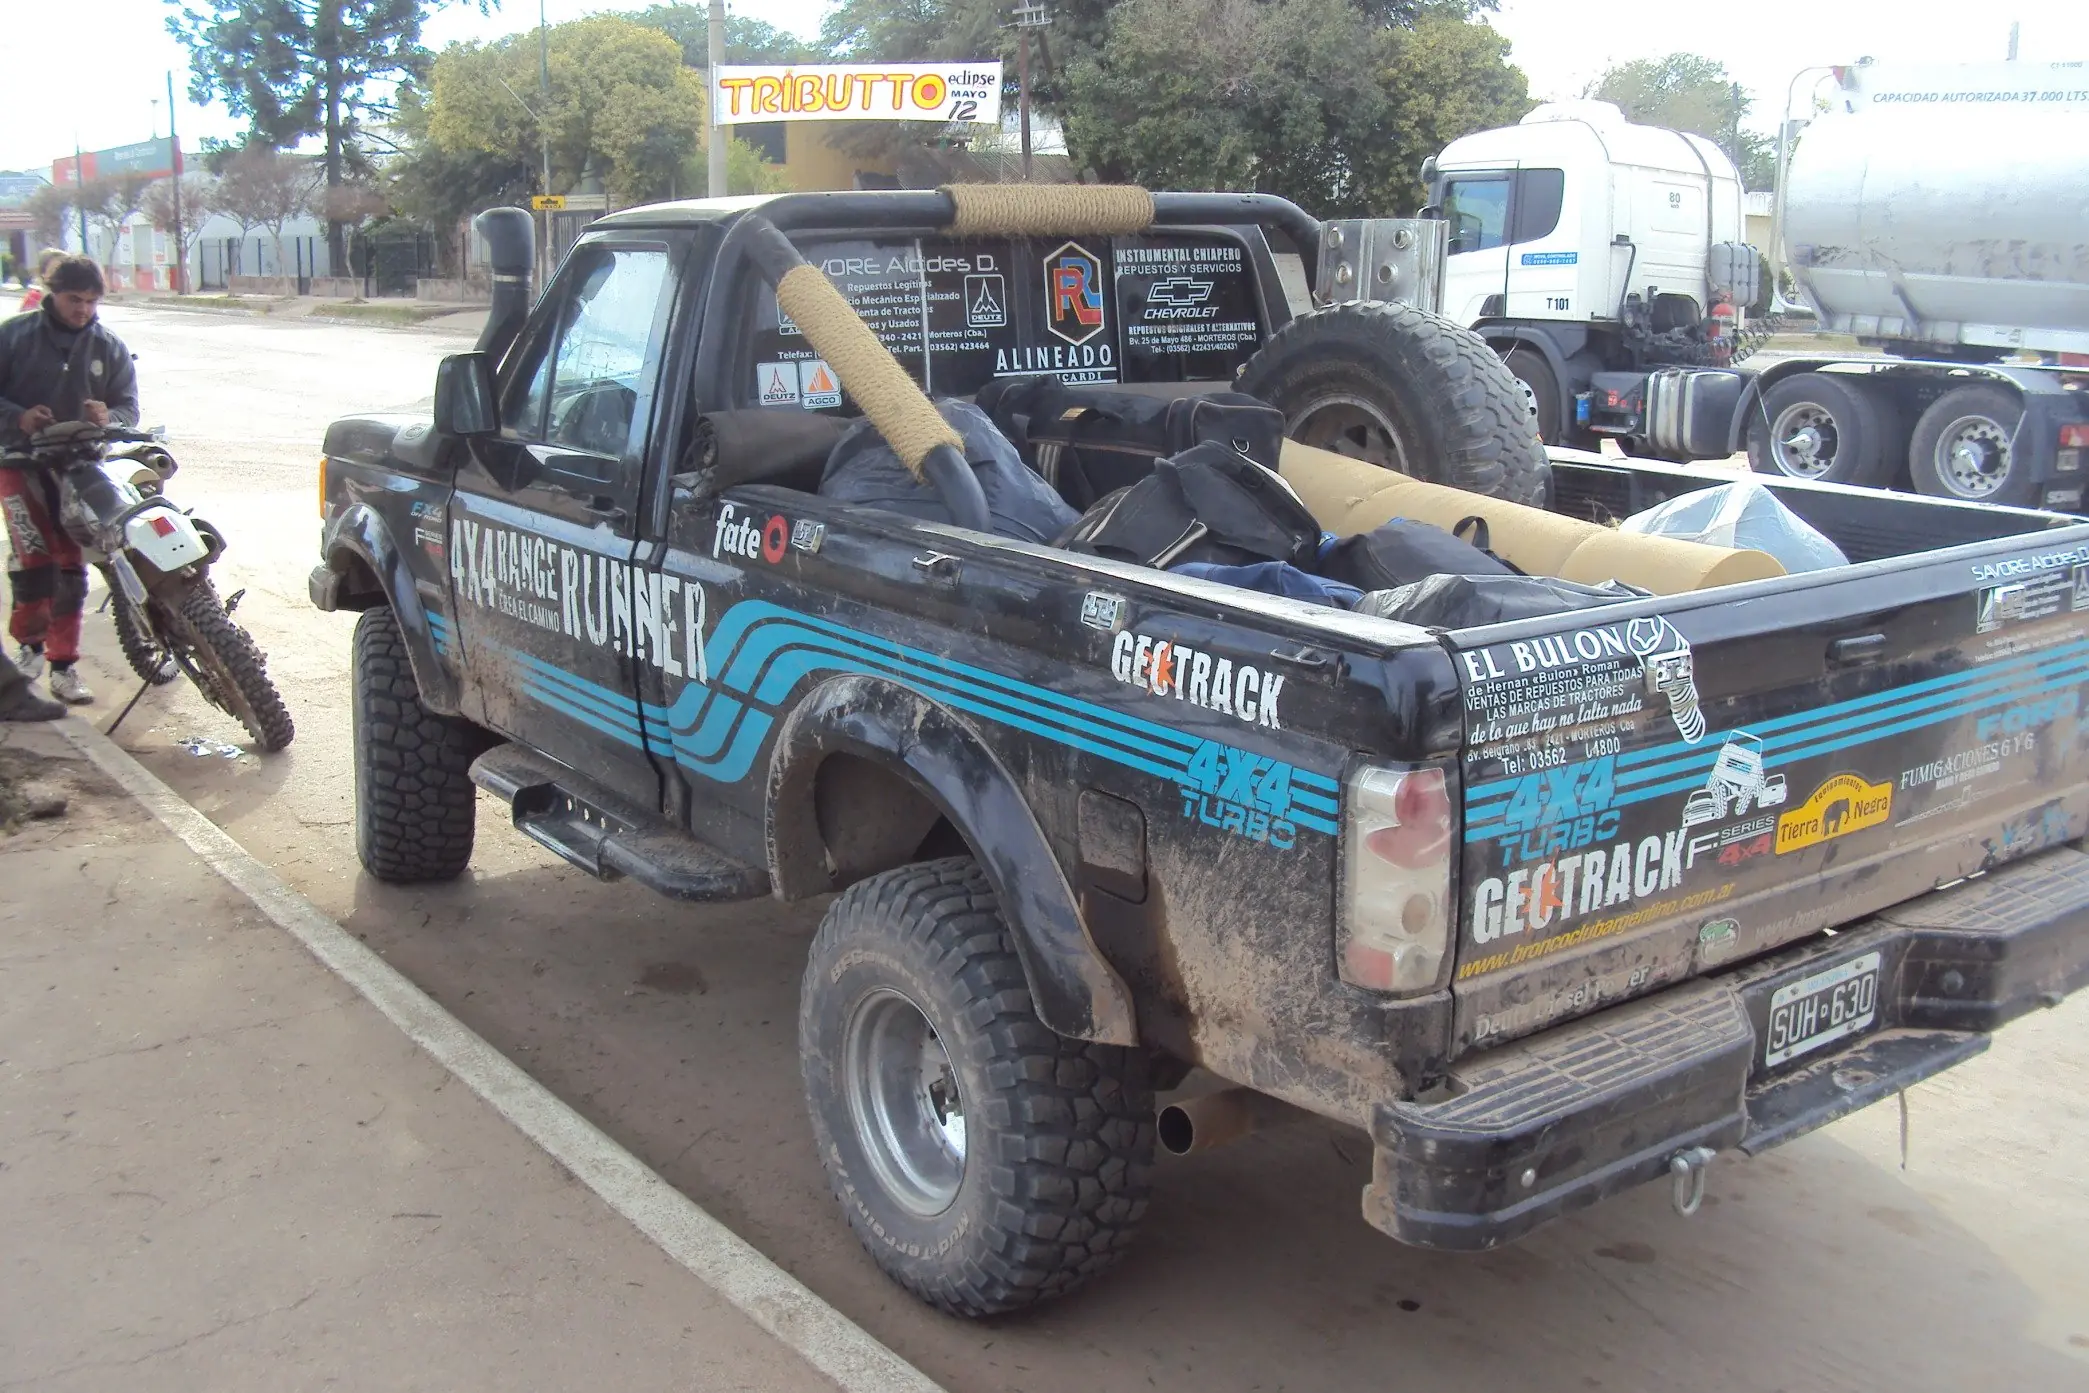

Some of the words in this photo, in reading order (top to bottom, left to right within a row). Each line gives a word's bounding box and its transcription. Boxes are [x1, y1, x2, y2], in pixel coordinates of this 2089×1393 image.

[948, 70, 995, 87] eclipse
[951, 91, 987, 99] MAYO
[1873, 93, 1938, 103] CAPACIDAD
[1941, 92, 2019, 102] AUTORIZADA
[2021, 91, 2063, 102] 37.000
[949, 101, 978, 120] 12
[1669, 192, 1681, 203] 80
[1116, 249, 1190, 263] INSTRUMENTAL
[1193, 248, 1241, 261] CHIAPERO
[1117, 264, 1177, 275] REPUESTOS
[1180, 264, 1187, 273] Y
[1190, 263, 1242, 273] SERVICIOS
[848, 282, 892, 293] Repuestos
[862, 294, 902, 306] Mecánico
[1555, 298, 1569, 310] 101
[881, 307, 892, 316] de
[893, 305, 933, 316] Tractoes
[1144, 306, 1219, 319] CHEVROLET
[881, 323, 887, 331] y
[888, 319, 920, 328] Usados
[901, 332, 922, 341] 2421
[1151, 336, 1160, 344] de
[1161, 336, 1179, 345] Mayo
[1198, 333, 1236, 342] MORTEROS
[778, 350, 813, 359] Telefax:
[887, 345, 902, 353] Tel.
[904, 344, 922, 353] Part.
[960, 342, 989, 350] 423464
[996, 344, 1112, 371] ALINEADO
[763, 392, 796, 400] DEUTZ
[808, 396, 836, 405] AGCO
[713, 504, 760, 559] fate
[1971, 558, 2031, 581] SAVORE
[451, 519, 496, 608] 4X4
[497, 530, 558, 601] RANGE
[561, 549, 707, 685] RUNNER
[529, 603, 560, 632] CAMINO
[1461, 648, 1505, 682] EL
[1510, 626, 1627, 673] BULON
[1111, 630, 1285, 730] GEOTRACK
[1468, 685, 1483, 697] de
[1486, 677, 1529, 693] Hernan
[1582, 660, 1620, 675] Roman
[1466, 692, 1507, 711] VENTAS
[1509, 689, 1523, 702] DE
[1525, 678, 1582, 700] REPUESTOS
[1585, 672, 1610, 687] PARA
[1613, 666, 1643, 682] TODAS
[1486, 706, 1506, 722] LAS
[1509, 698, 1550, 717] MARCAS
[1553, 696, 1566, 709] DE
[1568, 684, 1625, 705] TRACTORES
[1470, 724, 1486, 746] de
[1488, 720, 1503, 742] lo
[1505, 721, 1529, 742] que
[1531, 711, 1557, 734] hay
[1559, 713, 1575, 727] no
[1576, 703, 1609, 726] falta
[1611, 693, 1643, 717] nada
[1502, 756, 1526, 775] Tel:
[1529, 747, 1567, 770] 03562
[1721, 815, 1775, 839] SERIES
[1780, 819, 1818, 843] Tierra
[1853, 798, 1889, 819] Negra
[1498, 810, 1620, 867] TURBO
[1473, 826, 1688, 944] GEOTRACK
